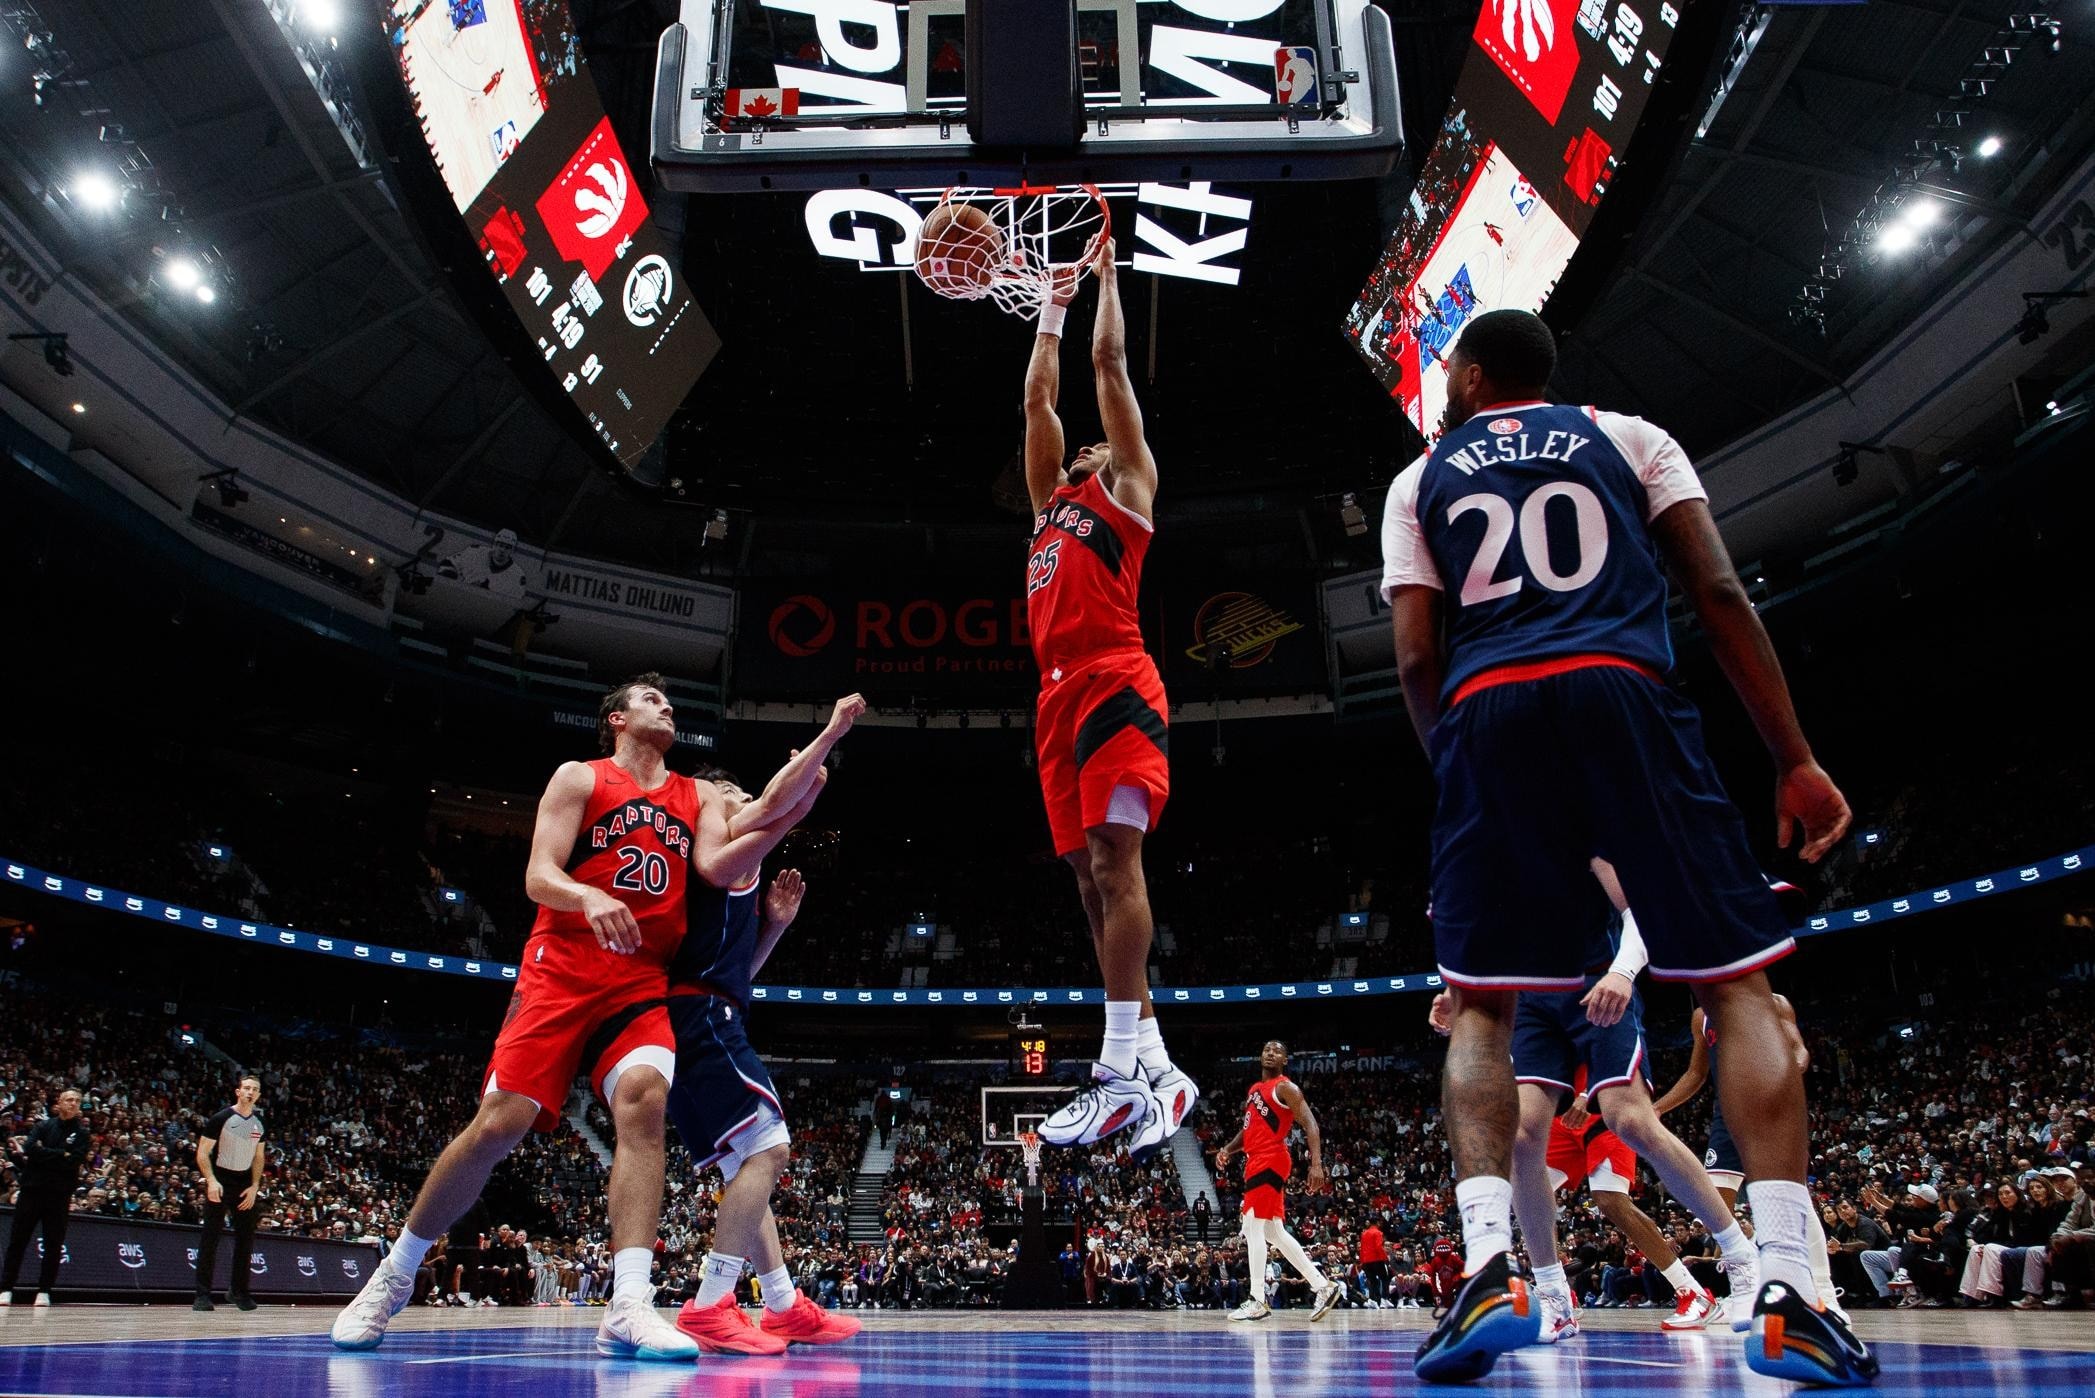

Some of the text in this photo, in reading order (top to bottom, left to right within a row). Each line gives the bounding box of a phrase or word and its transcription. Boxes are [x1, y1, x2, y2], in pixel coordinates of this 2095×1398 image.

[1660, 1, 1680, 29] 13
[1606, 2, 1644, 67] 4:19
[1645, 50, 1662, 69] 4
[1593, 74, 1623, 121] 101
[719, 137, 725, 147] 6
[525, 266, 553, 307] 101
[552, 301, 585, 350] 4:19
[562, 372, 579, 393] 13
[580, 353, 604, 386] 91
[609, 440, 618, 451] 2
[1445, 430, 1590, 477] WESLEY
[417, 524, 445, 560] 2
[1446, 481, 1609, 608] 20
[1028, 538, 1063, 600] 25
[546, 570, 695, 618] MATTIAS OHLUND
[855, 597, 1029, 650] ROGE
[855, 656, 1027, 674] Proud Partner
[553, 711, 714, 748] VANCOU ALUMNI
[592, 805, 690, 859] RAPTORS
[613, 845, 670, 896] 20
[2020, 867, 2039, 878] aws
[2063, 854, 2081, 866] aws
[1933, 889, 1950, 899] aws
[1975, 878, 1994, 889] aws
[1853, 909, 1870, 919] aws
[1892, 899, 1909, 909] aws
[1810, 917, 1828, 927] aws
[1021, 1040, 1046, 1053] 4:18
[1023, 1053, 1044, 1075] 13
[118, 1242, 358, 1271] aws ws aws aws
